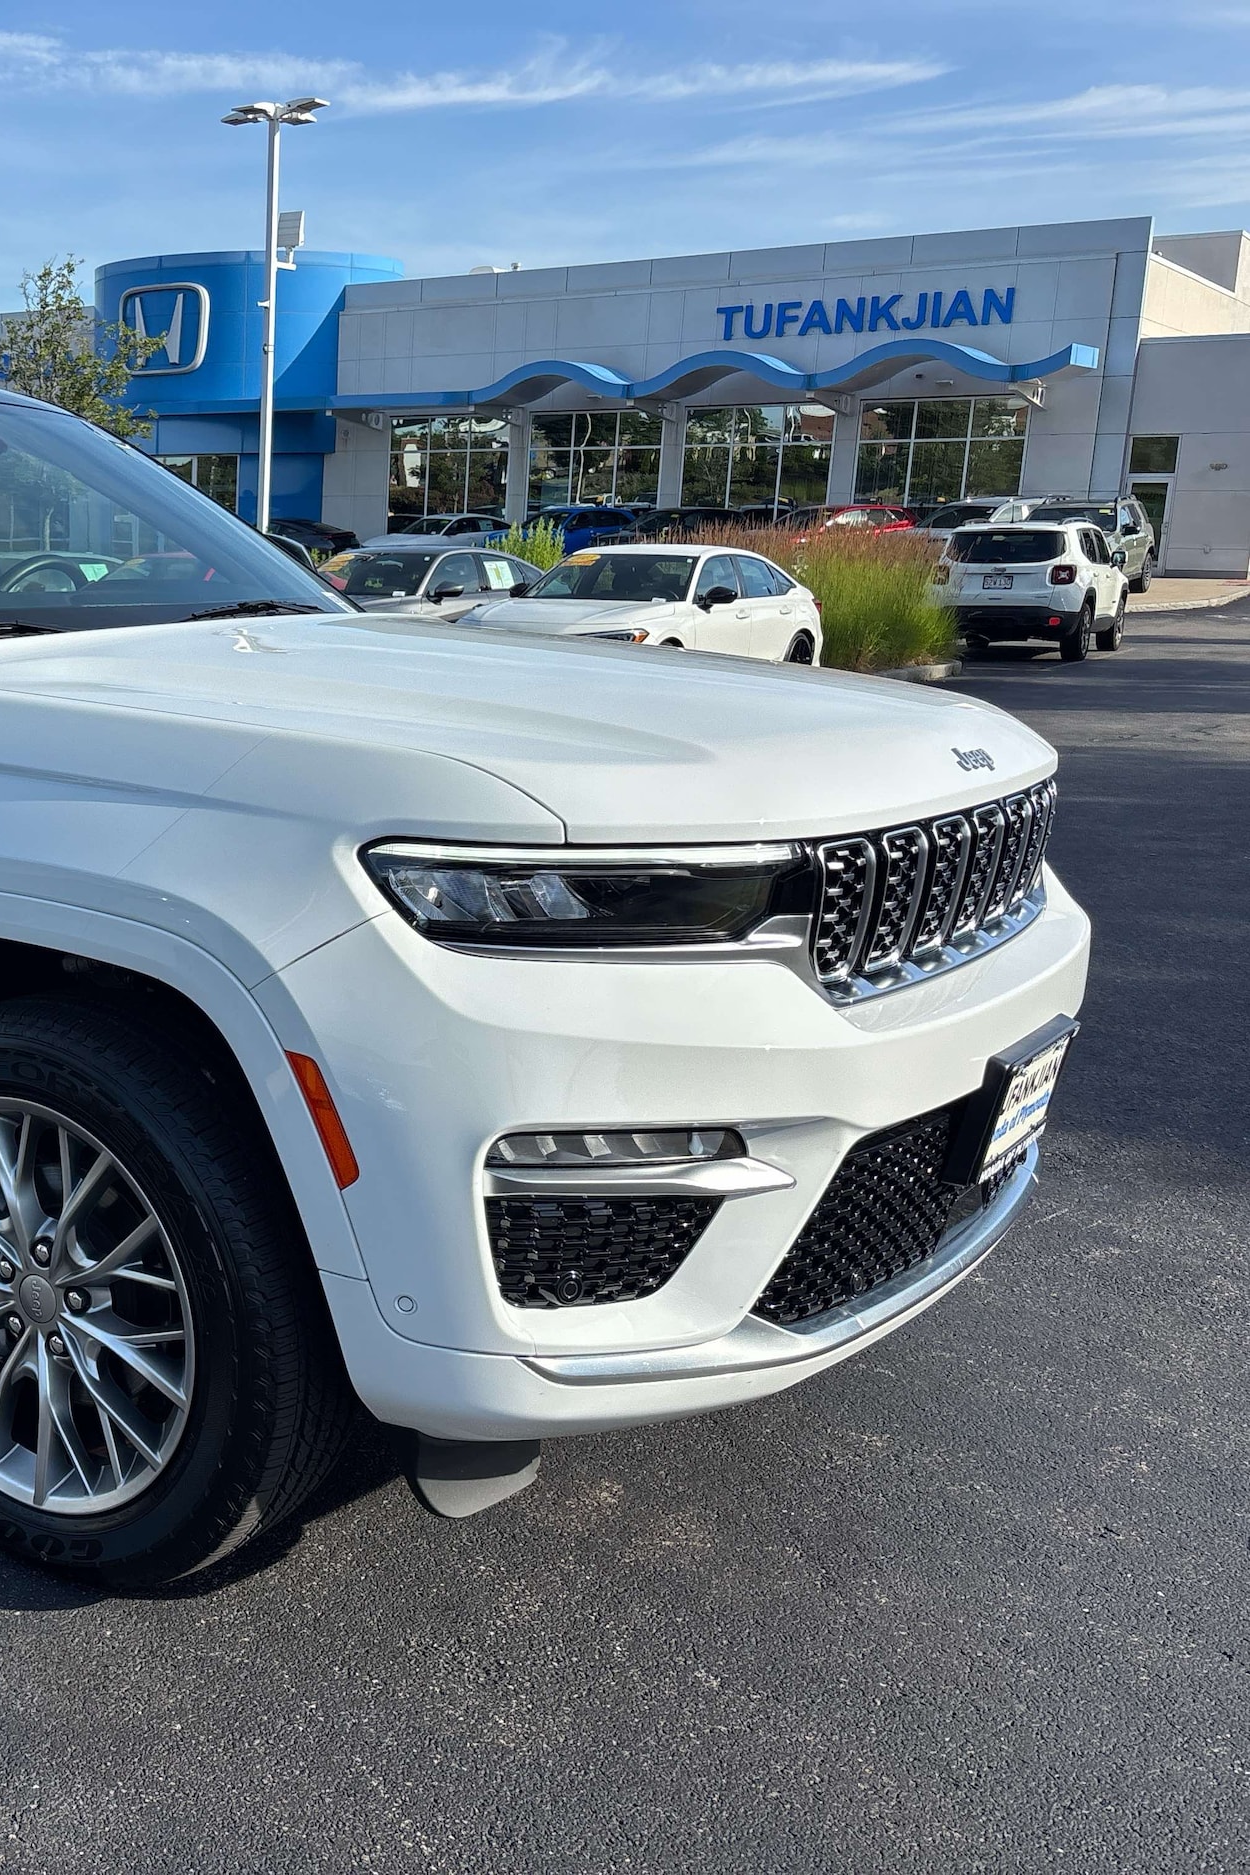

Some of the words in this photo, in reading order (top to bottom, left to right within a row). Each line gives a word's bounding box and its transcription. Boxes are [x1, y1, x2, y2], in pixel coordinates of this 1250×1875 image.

[717, 287, 1015, 340] TUFANKJIAN
[950, 747, 996, 772] Jeep
[1002, 1054, 1063, 1112] UFANKJIAN
[31, 1280, 43, 1317] Jeep
